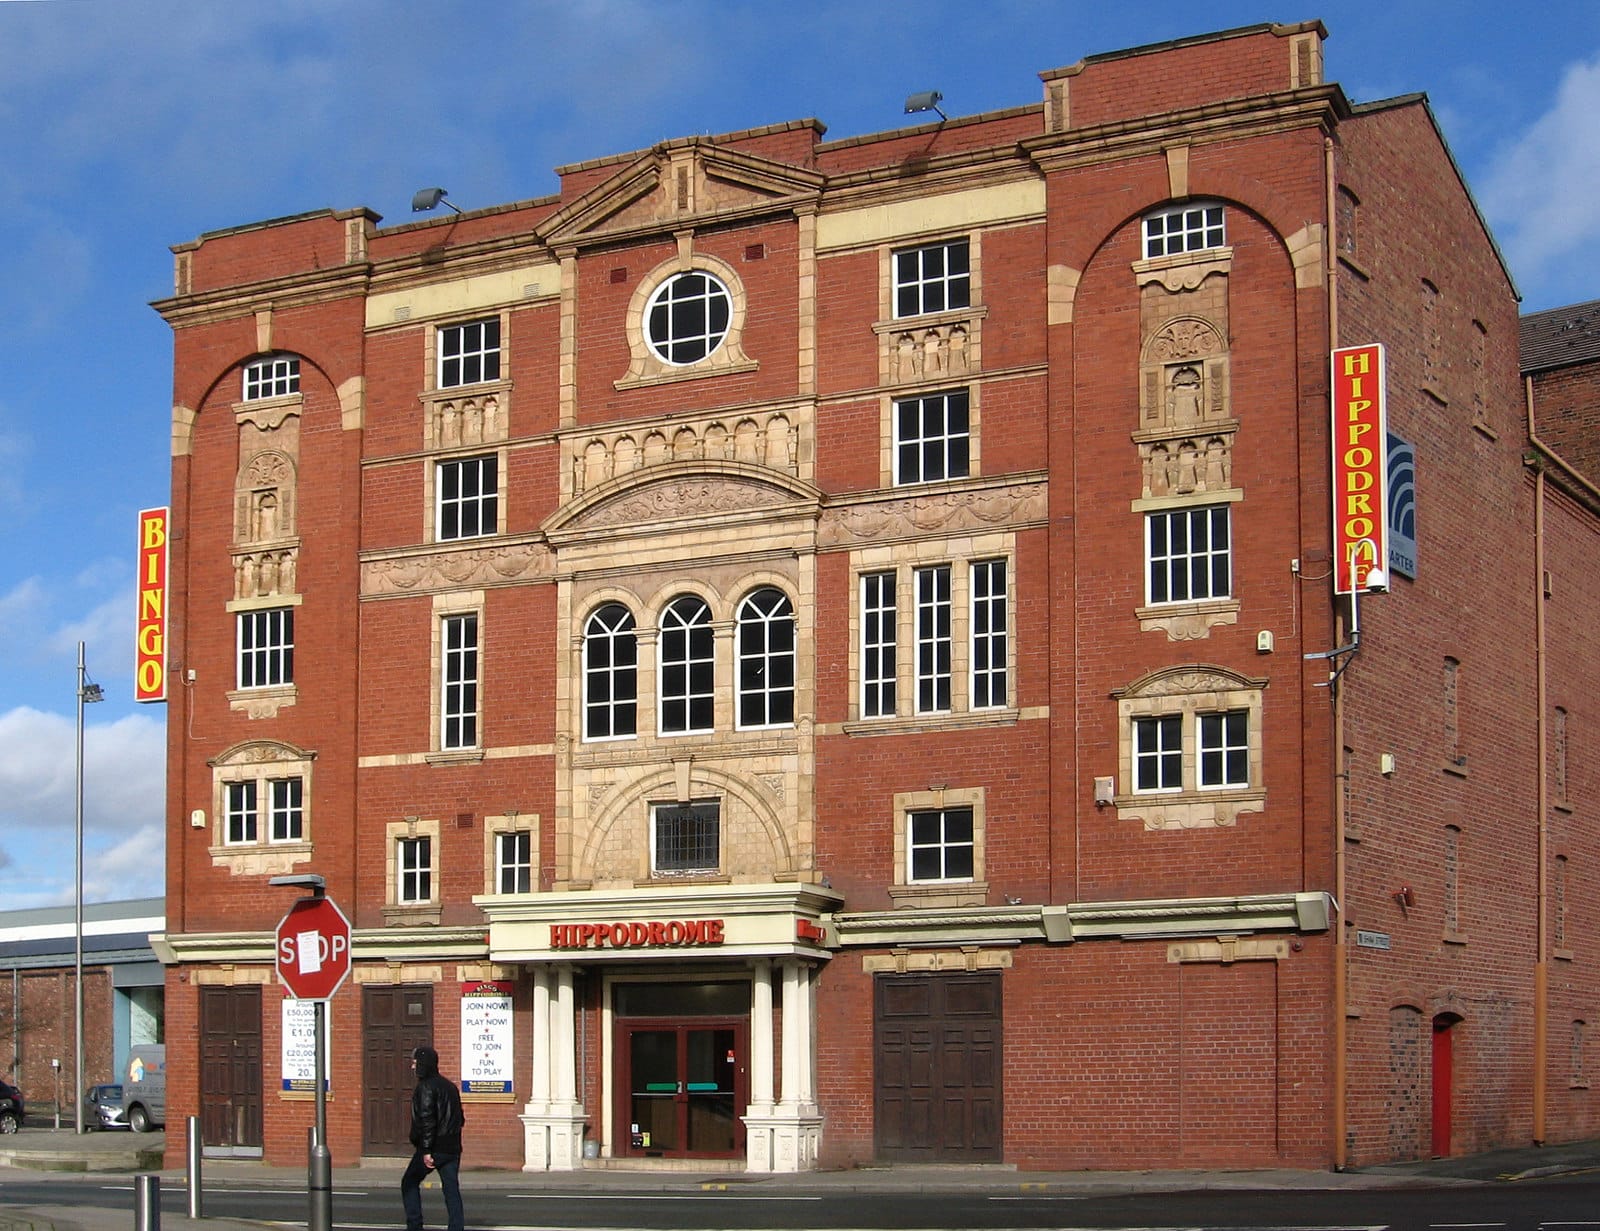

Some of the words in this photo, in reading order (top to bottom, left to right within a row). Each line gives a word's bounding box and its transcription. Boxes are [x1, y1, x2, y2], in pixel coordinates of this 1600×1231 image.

[138, 517, 165, 693] BINGO
[549, 919, 725, 948] HIPPODROME
[486, 1002, 509, 1010] NOW!
[466, 1018, 485, 1026] PLAY
[486, 1018, 507, 1026] NOW!
[478, 1034, 495, 1042] FREE
[472, 1043, 482, 1051] TO
[484, 1043, 502, 1051] JOIN
